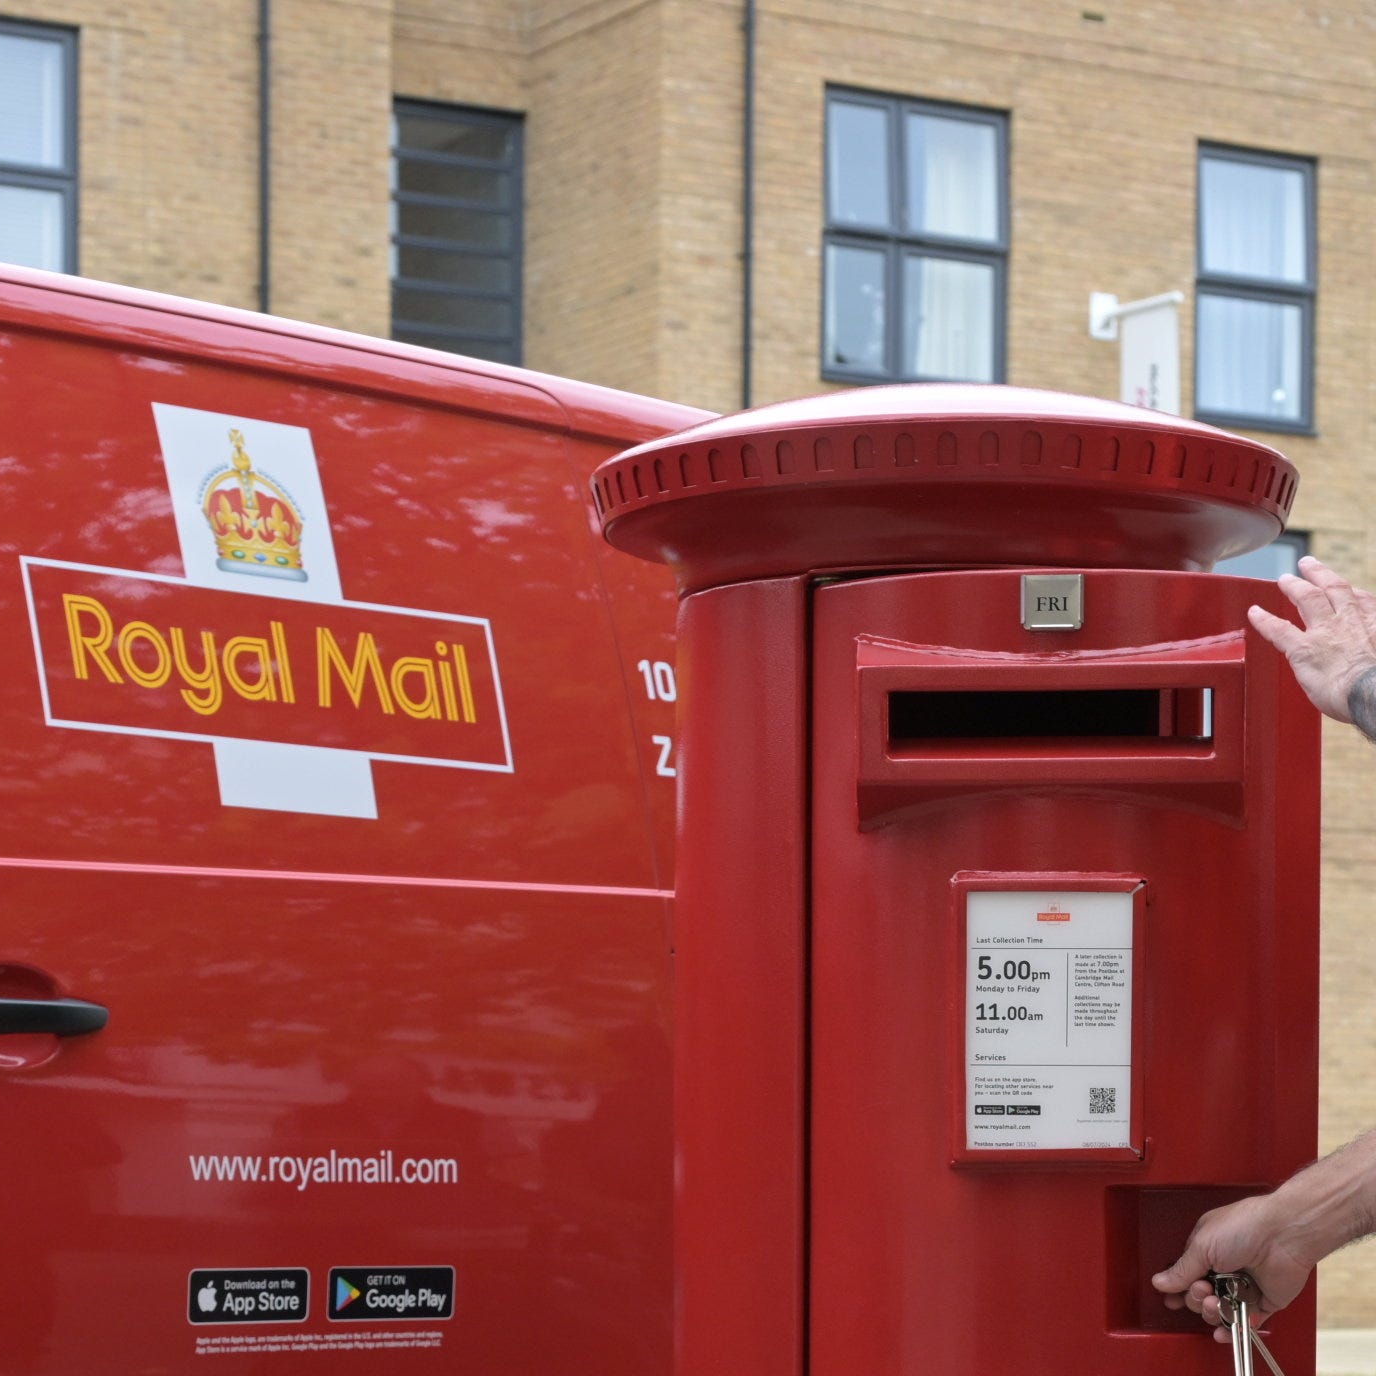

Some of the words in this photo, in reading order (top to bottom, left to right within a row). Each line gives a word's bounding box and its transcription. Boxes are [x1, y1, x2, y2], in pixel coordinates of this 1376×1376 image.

[1036, 596, 1069, 611] FRI
[61, 593, 295, 715] Royal
[316, 626, 476, 723] Mail
[978, 955, 1050, 982] 5.00pm
[976, 985, 1004, 994] Monday
[1017, 985, 1040, 994] Friday
[976, 1003, 1043, 1020] 11.00am
[975, 1027, 1009, 1035] Saturday
[189, 1149, 458, 1191] www.royalmail.com
[224, 1279, 267, 1290] Download
[268, 1281, 280, 1289] on
[281, 1279, 296, 1289] the
[366, 1275, 383, 1286] GET
[384, 1275, 392, 1286] IT
[392, 1275, 406, 1286] ON
[223, 1291, 256, 1315] App
[258, 1291, 300, 1311] Store
[365, 1288, 417, 1313] Google
[417, 1288, 446, 1312] Play
